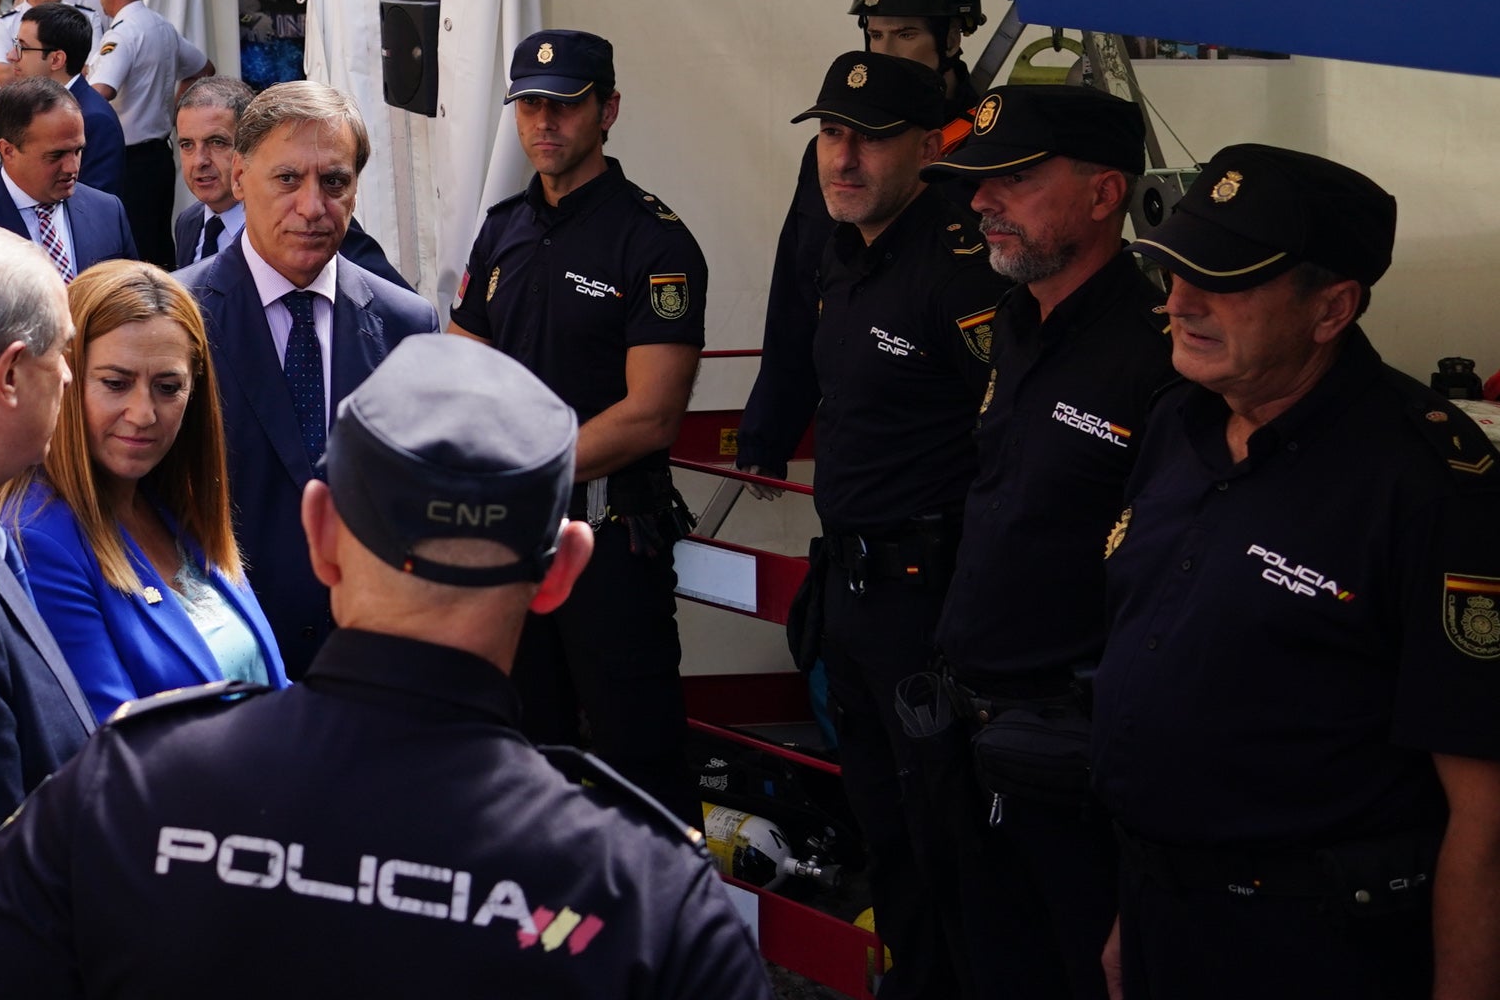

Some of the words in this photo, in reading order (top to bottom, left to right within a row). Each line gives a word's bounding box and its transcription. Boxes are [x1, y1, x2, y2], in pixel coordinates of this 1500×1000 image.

[565, 271, 616, 295] POLICIA
[575, 285, 606, 298] CNP
[870, 326, 916, 351] POLICIA
[877, 341, 908, 356] CNP
[1052, 410, 1128, 448] NACIONAL
[1055, 401, 1112, 432] POLICIA
[426, 500, 508, 528] CNP
[1247, 544, 1338, 596] POLICIA
[1262, 568, 1316, 597] CNP
[154, 825, 538, 937] POLICIA
